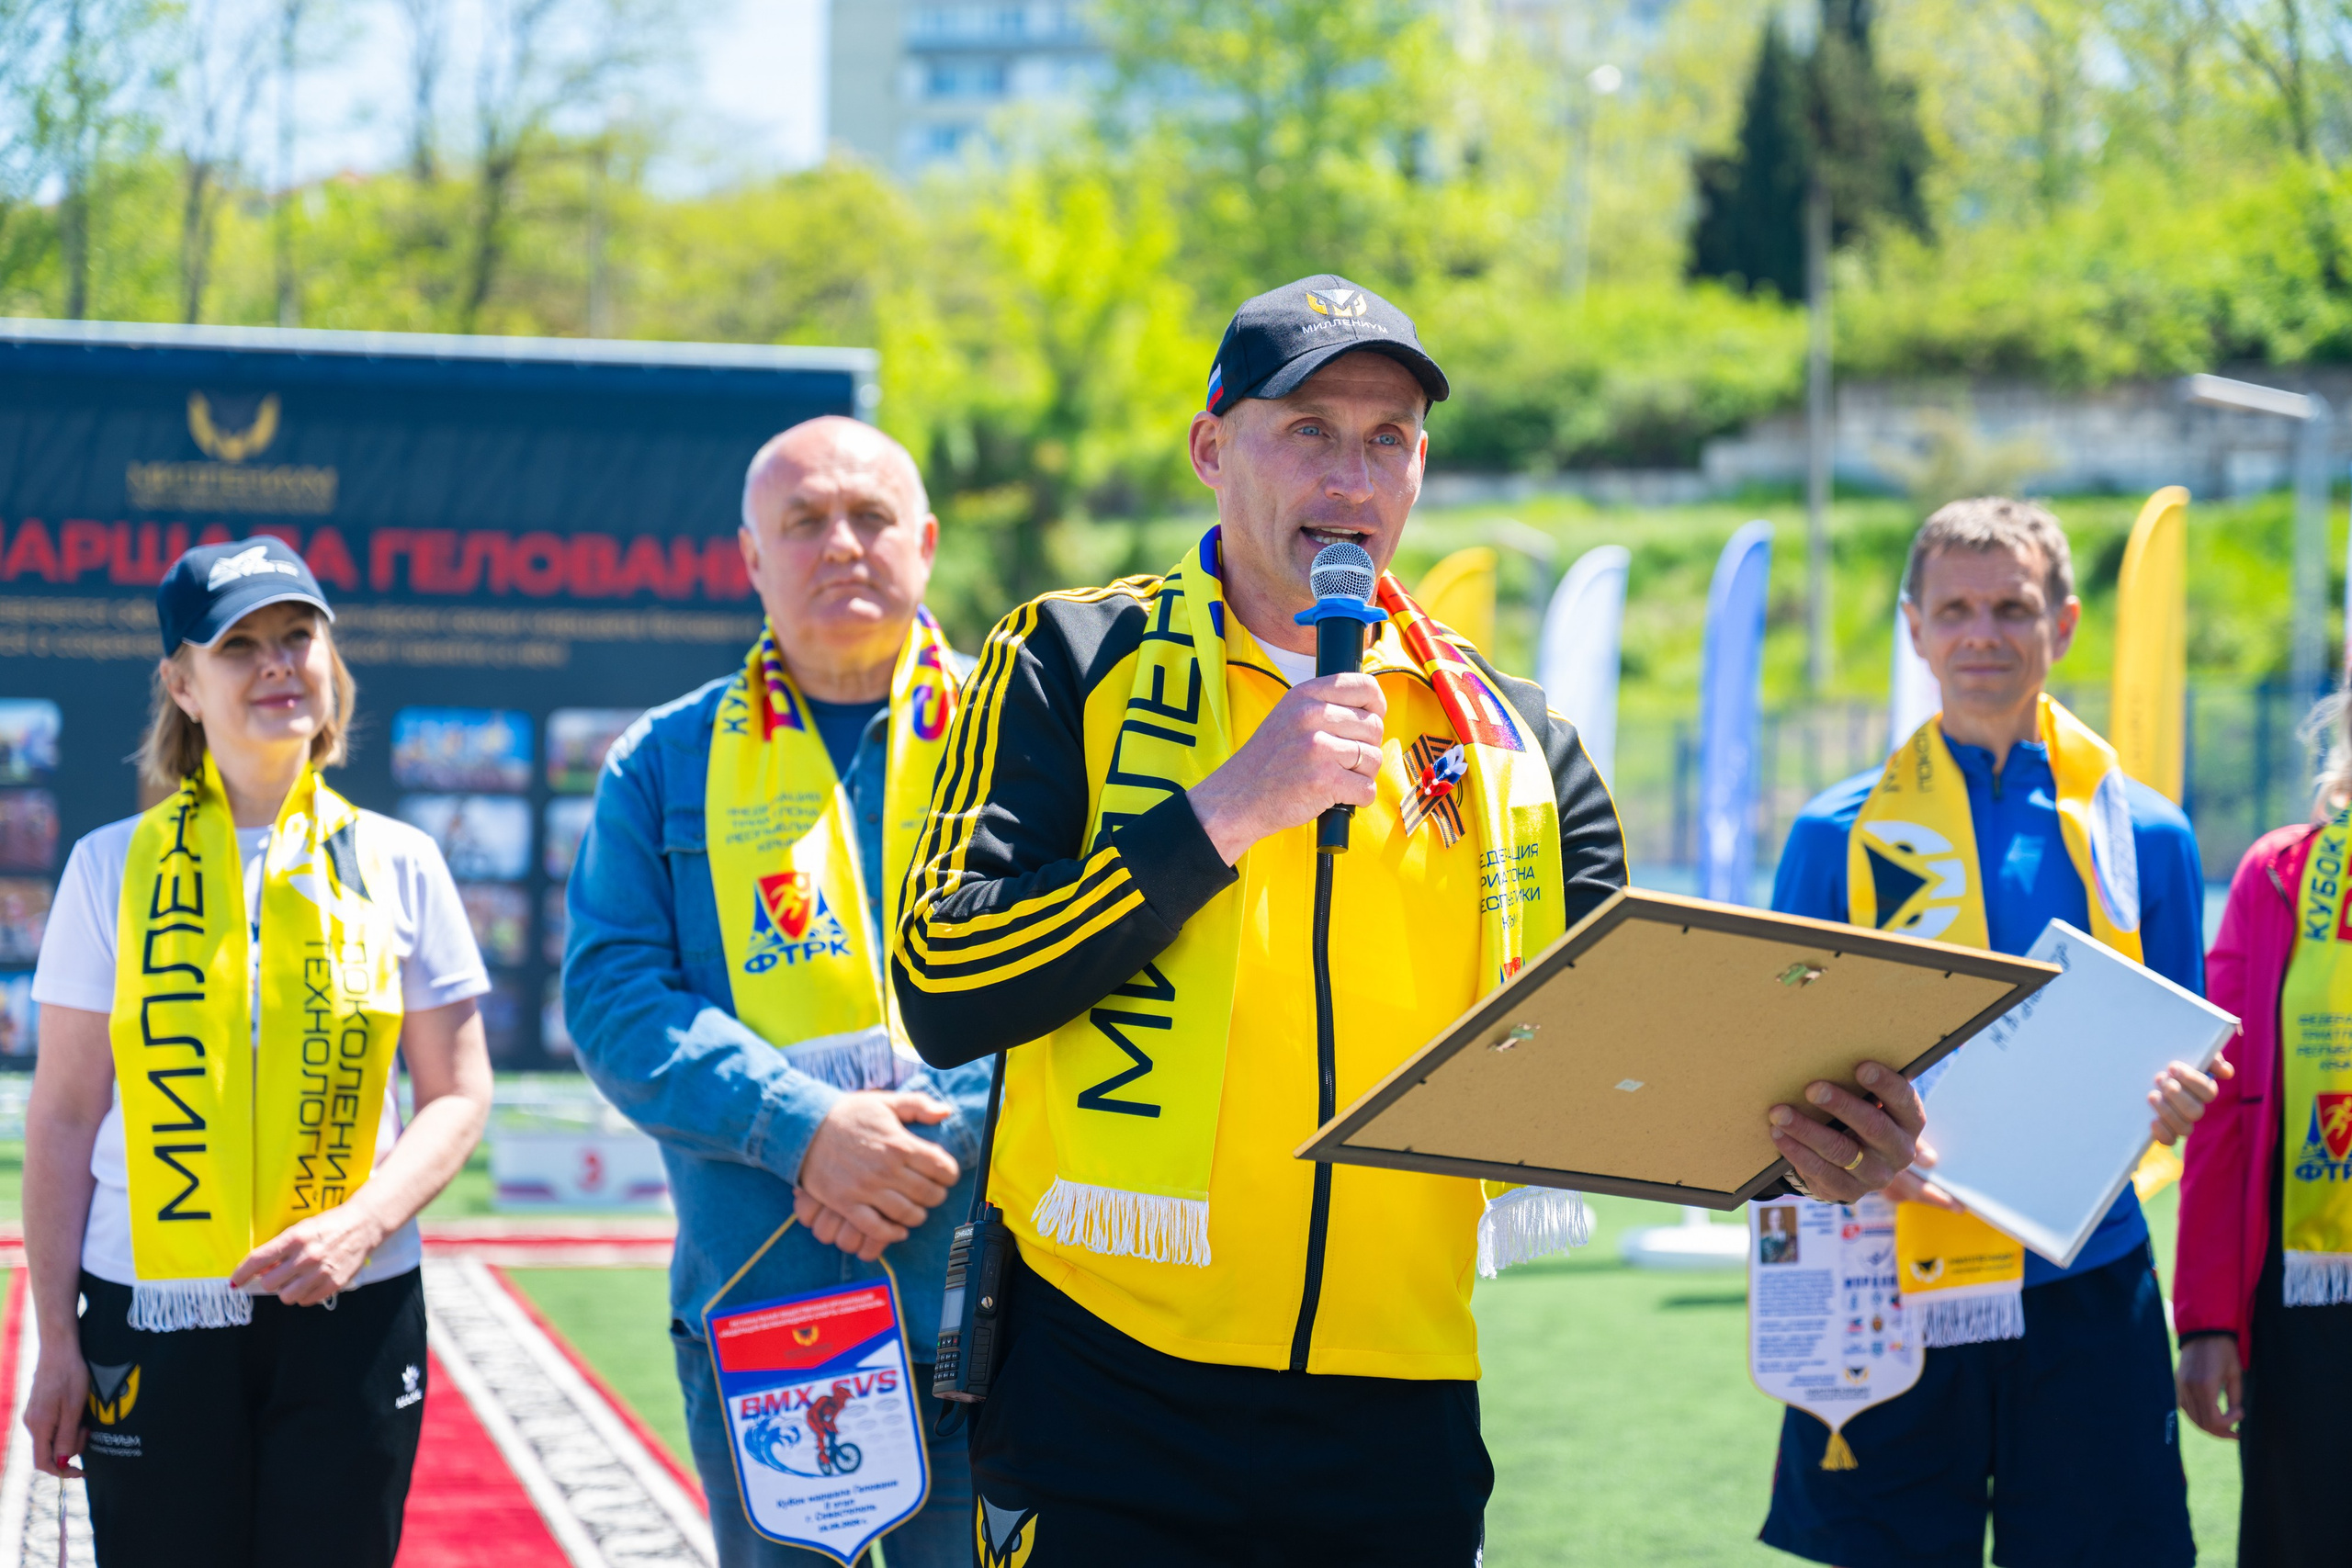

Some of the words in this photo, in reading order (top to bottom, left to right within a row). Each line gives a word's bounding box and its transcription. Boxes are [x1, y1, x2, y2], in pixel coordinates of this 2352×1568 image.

[1301, 318, 1388, 334] МИЛЛЕНИУМ
[0, 518, 359, 592] АРША
[2302, 834, 2346, 942] КУБОК
[141, 772, 211, 1222] МИЛЛЕН
[743, 938, 854, 974] ФТРК
[291, 940, 332, 1211] ТЕХНОЛОГИЙ
[321, 939, 369, 1210] ПОКОЛЕНИЕ
[741, 1385, 814, 1420] BMX
